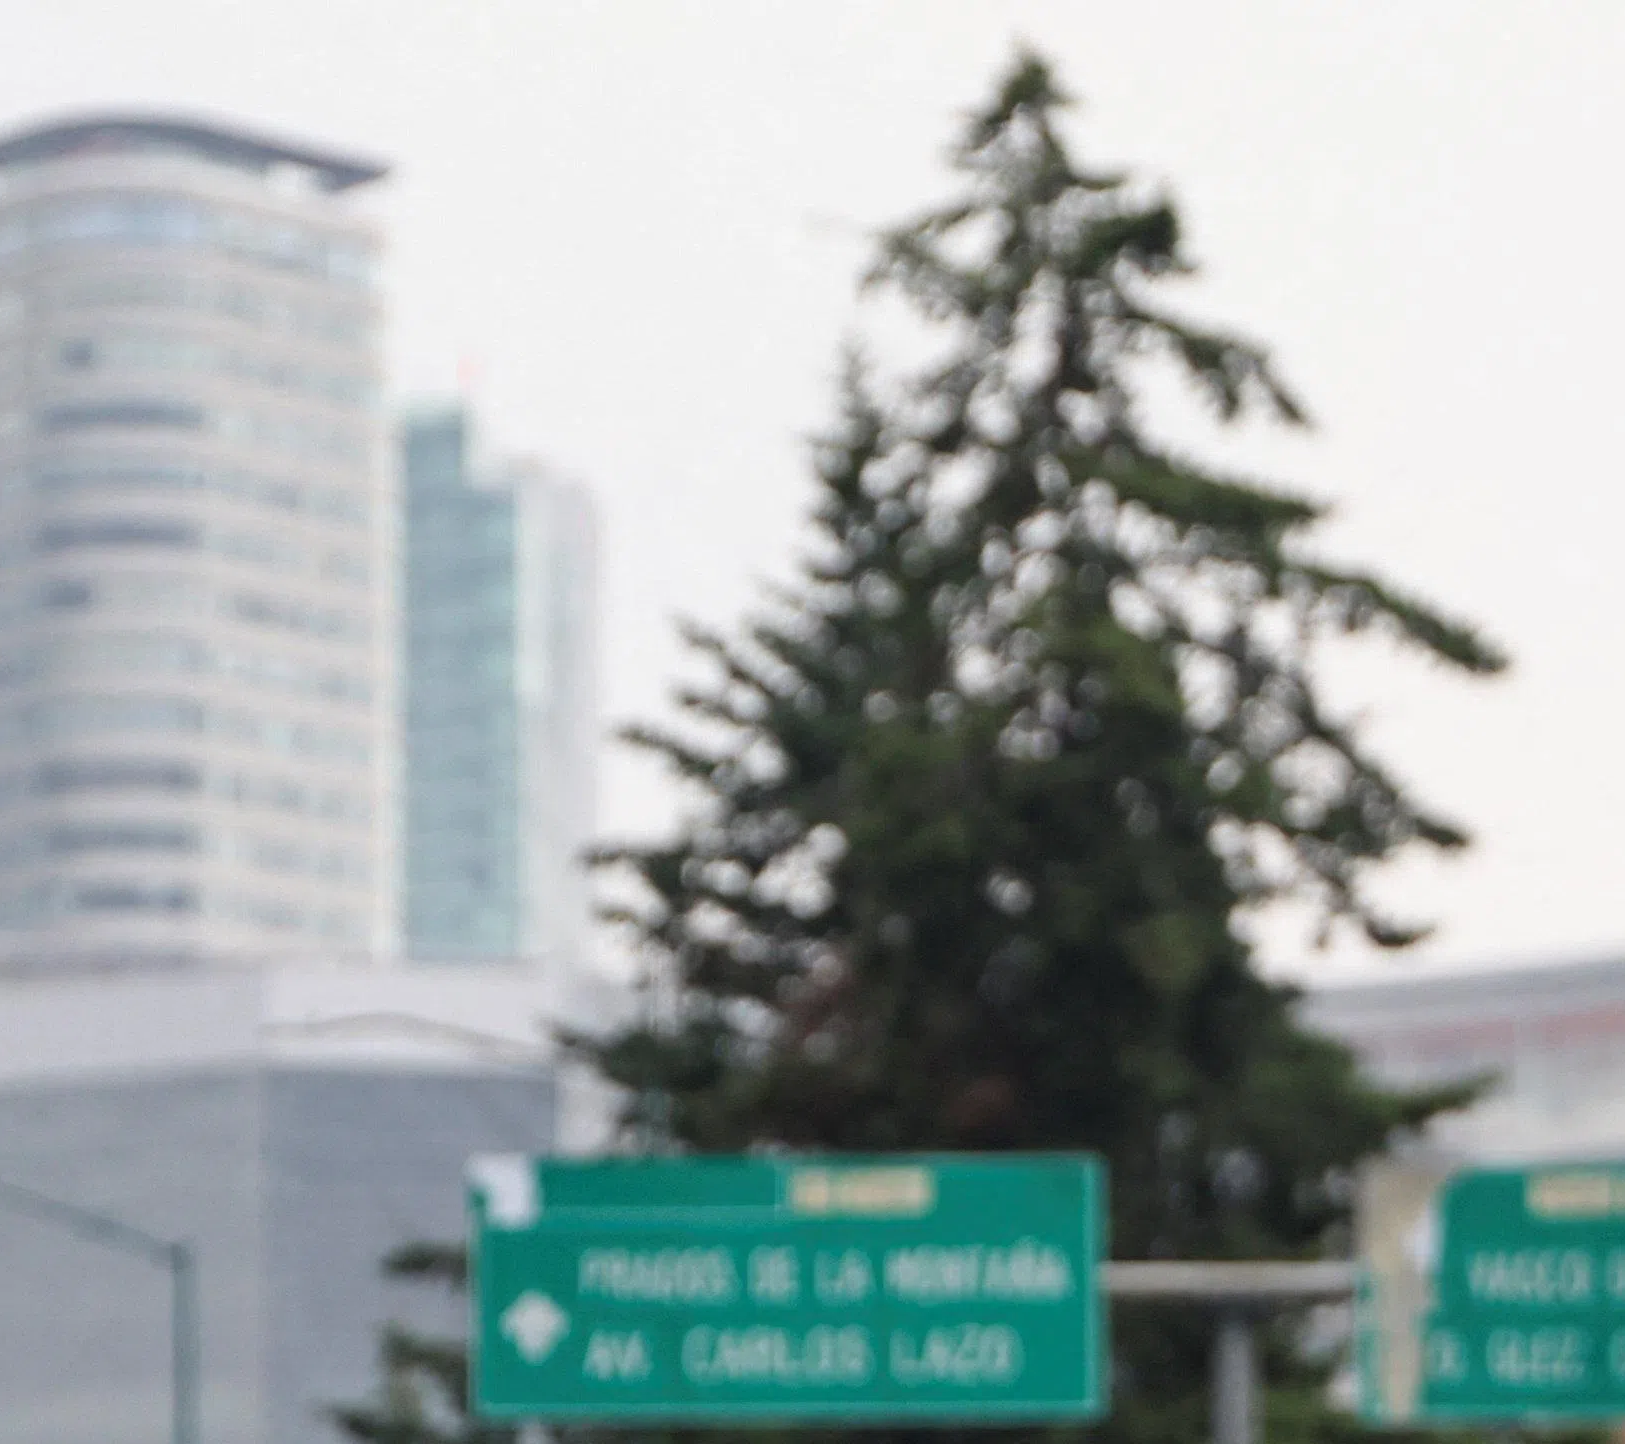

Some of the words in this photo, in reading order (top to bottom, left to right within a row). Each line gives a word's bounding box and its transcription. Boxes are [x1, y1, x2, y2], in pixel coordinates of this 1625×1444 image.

[748, 1246, 798, 1304] DE
[814, 1248, 871, 1304] LA
[682, 1324, 874, 1385] CARLOS
[889, 1323, 1023, 1386] LAZO
